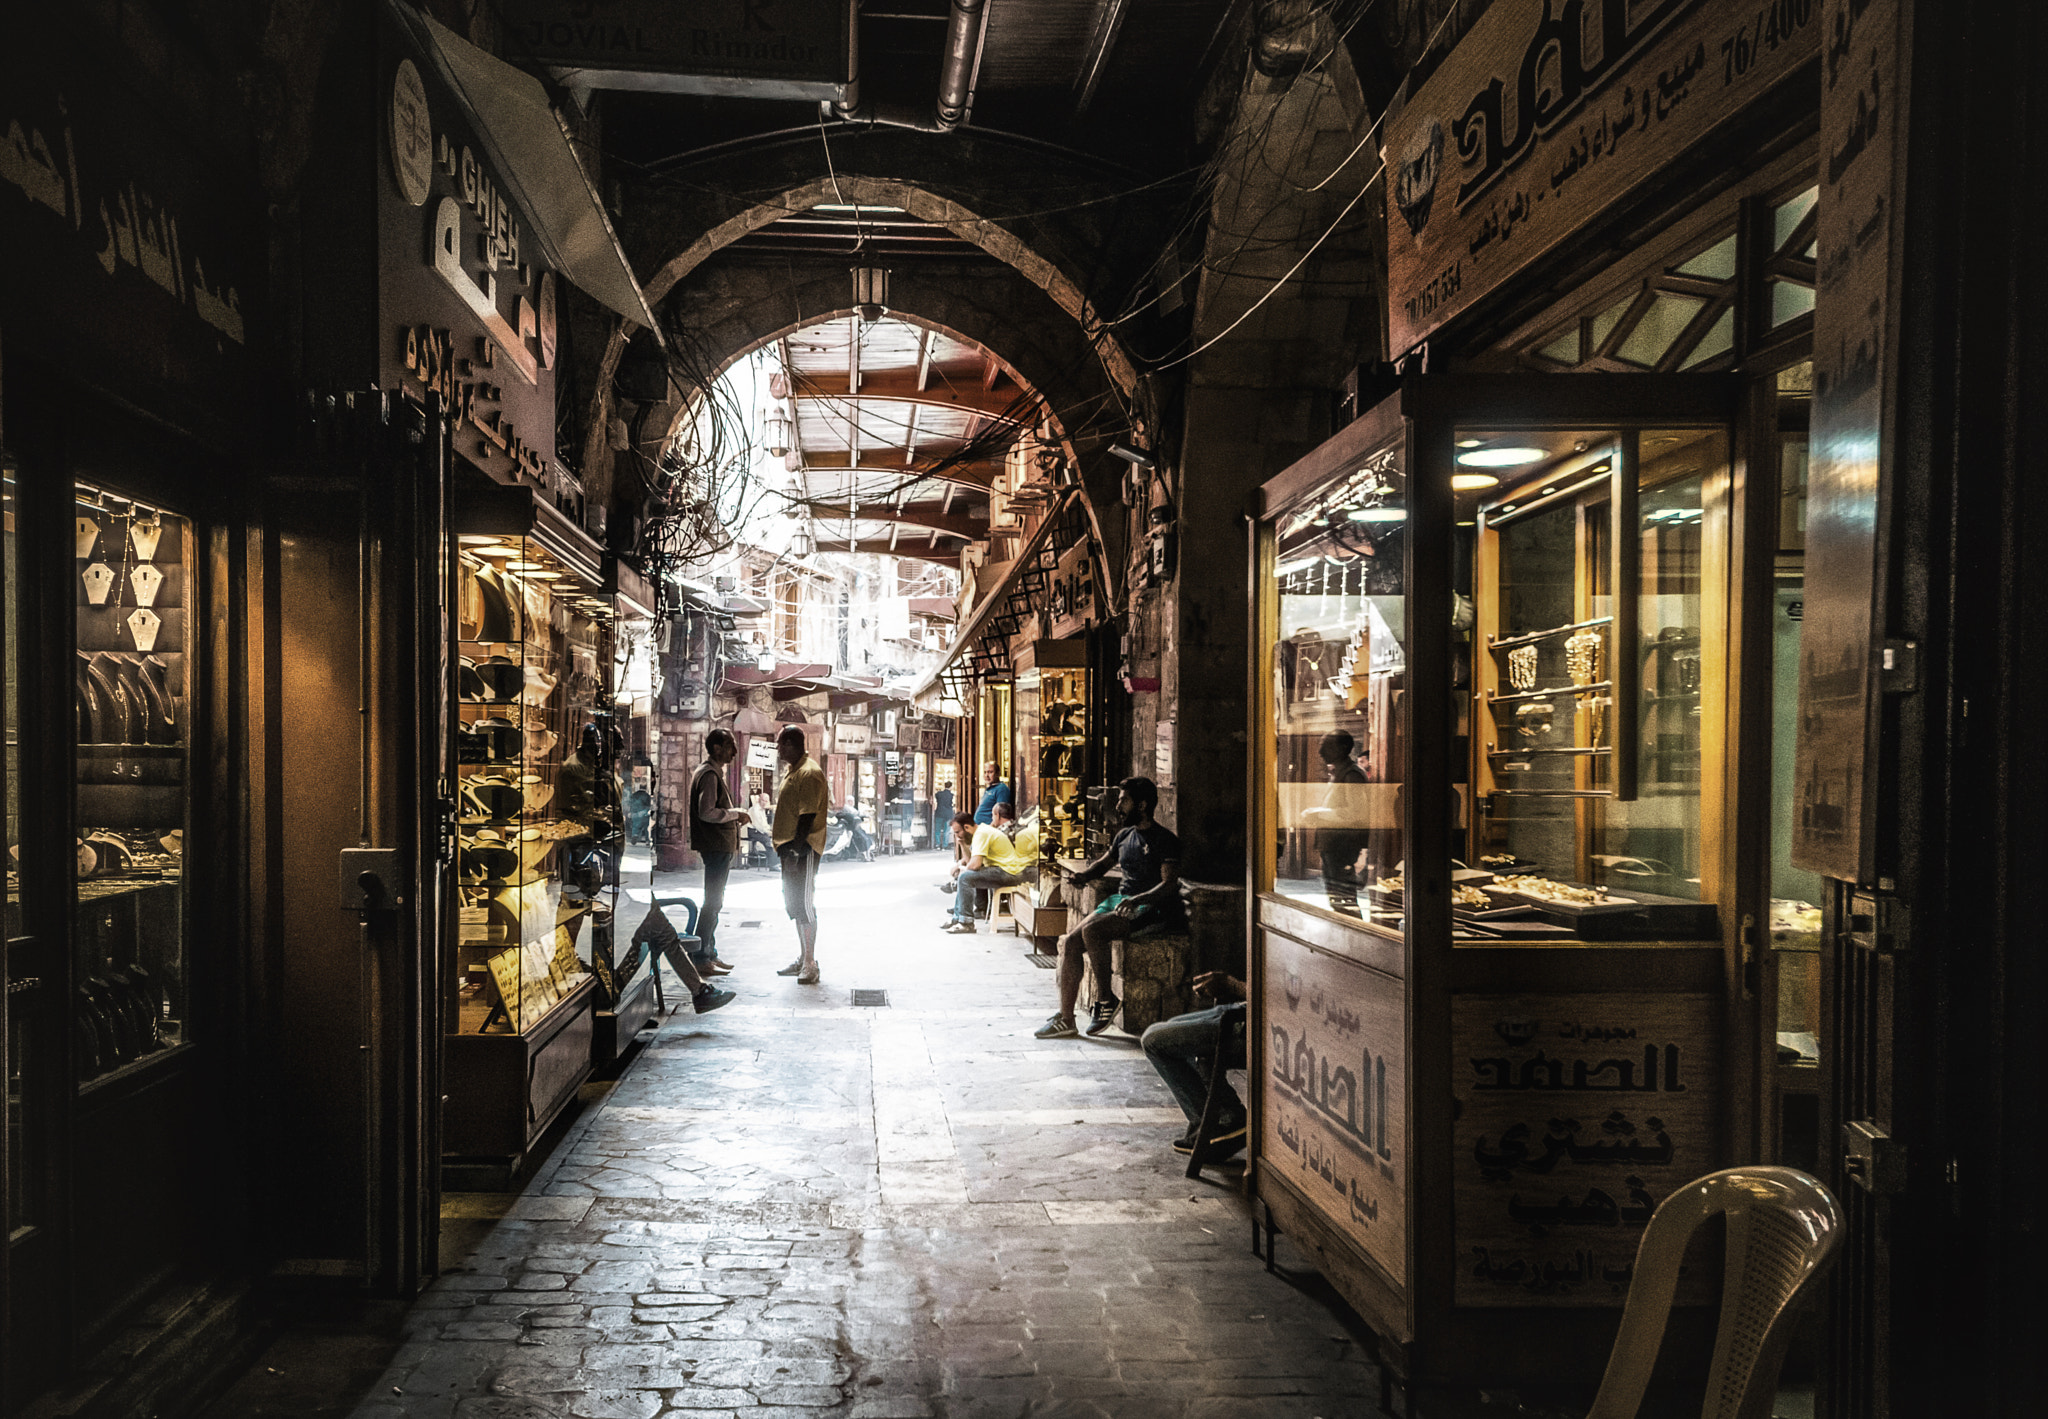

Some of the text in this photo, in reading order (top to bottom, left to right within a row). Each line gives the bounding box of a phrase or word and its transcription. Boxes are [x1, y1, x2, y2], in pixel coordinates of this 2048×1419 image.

[527, 20, 819, 63] JOVIAL Rimador
[1550, 126, 1589, 199] ذهب
[461, 145, 520, 269] GHIEH
[1469, 202, 1498, 265] ذهب
[192, 254, 246, 355] عبد
[1557, 1021, 1637, 1044] مجوهرات
[1473, 1111, 1675, 1183] نشتري
[1507, 1175, 1654, 1239] ذهب
[1472, 1246, 1594, 1295] البورصة
